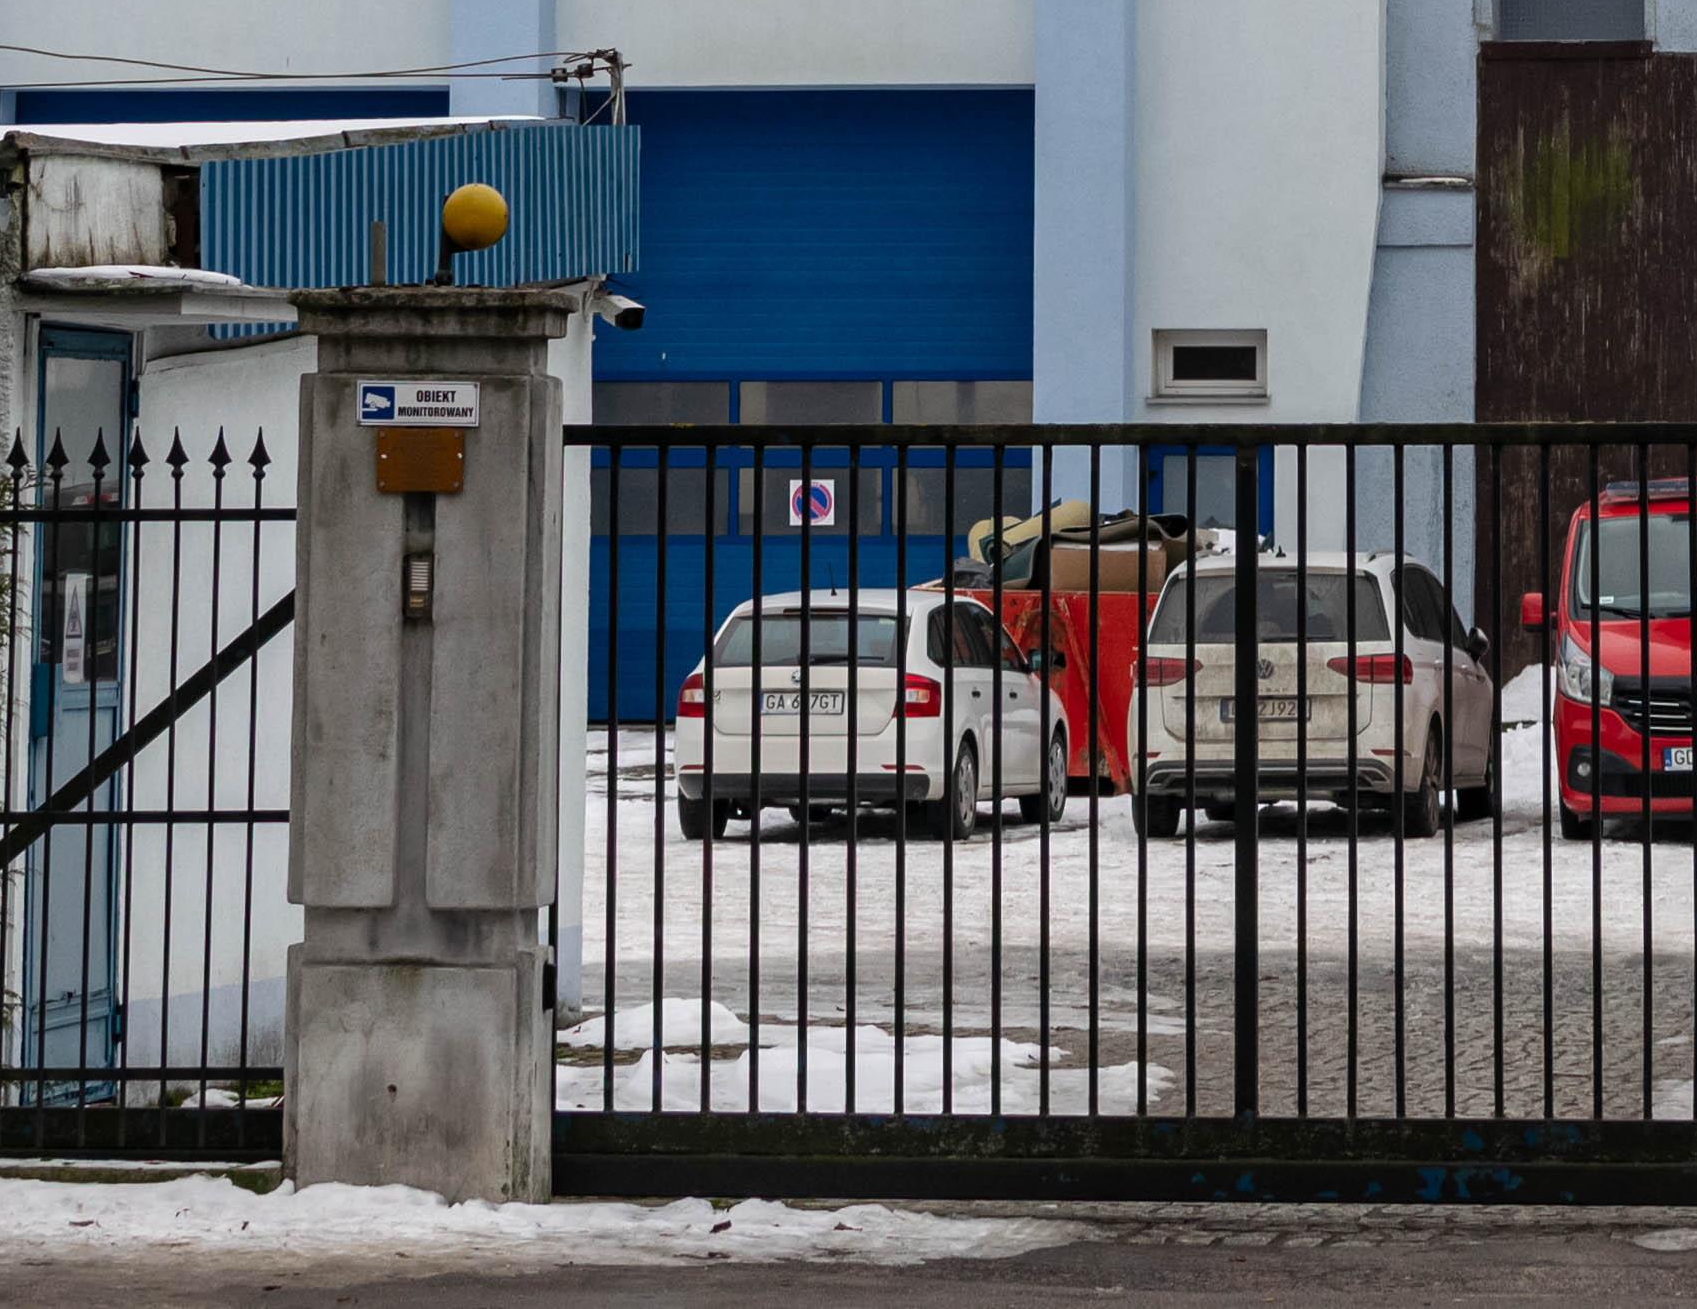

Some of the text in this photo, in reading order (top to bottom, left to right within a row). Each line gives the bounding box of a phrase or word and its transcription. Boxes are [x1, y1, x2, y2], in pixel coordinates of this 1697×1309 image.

[416, 390, 456, 403] OBIEKT
[398, 407, 474, 417] MONITOROWANY
[766, 694, 839, 710] GA 67GT
